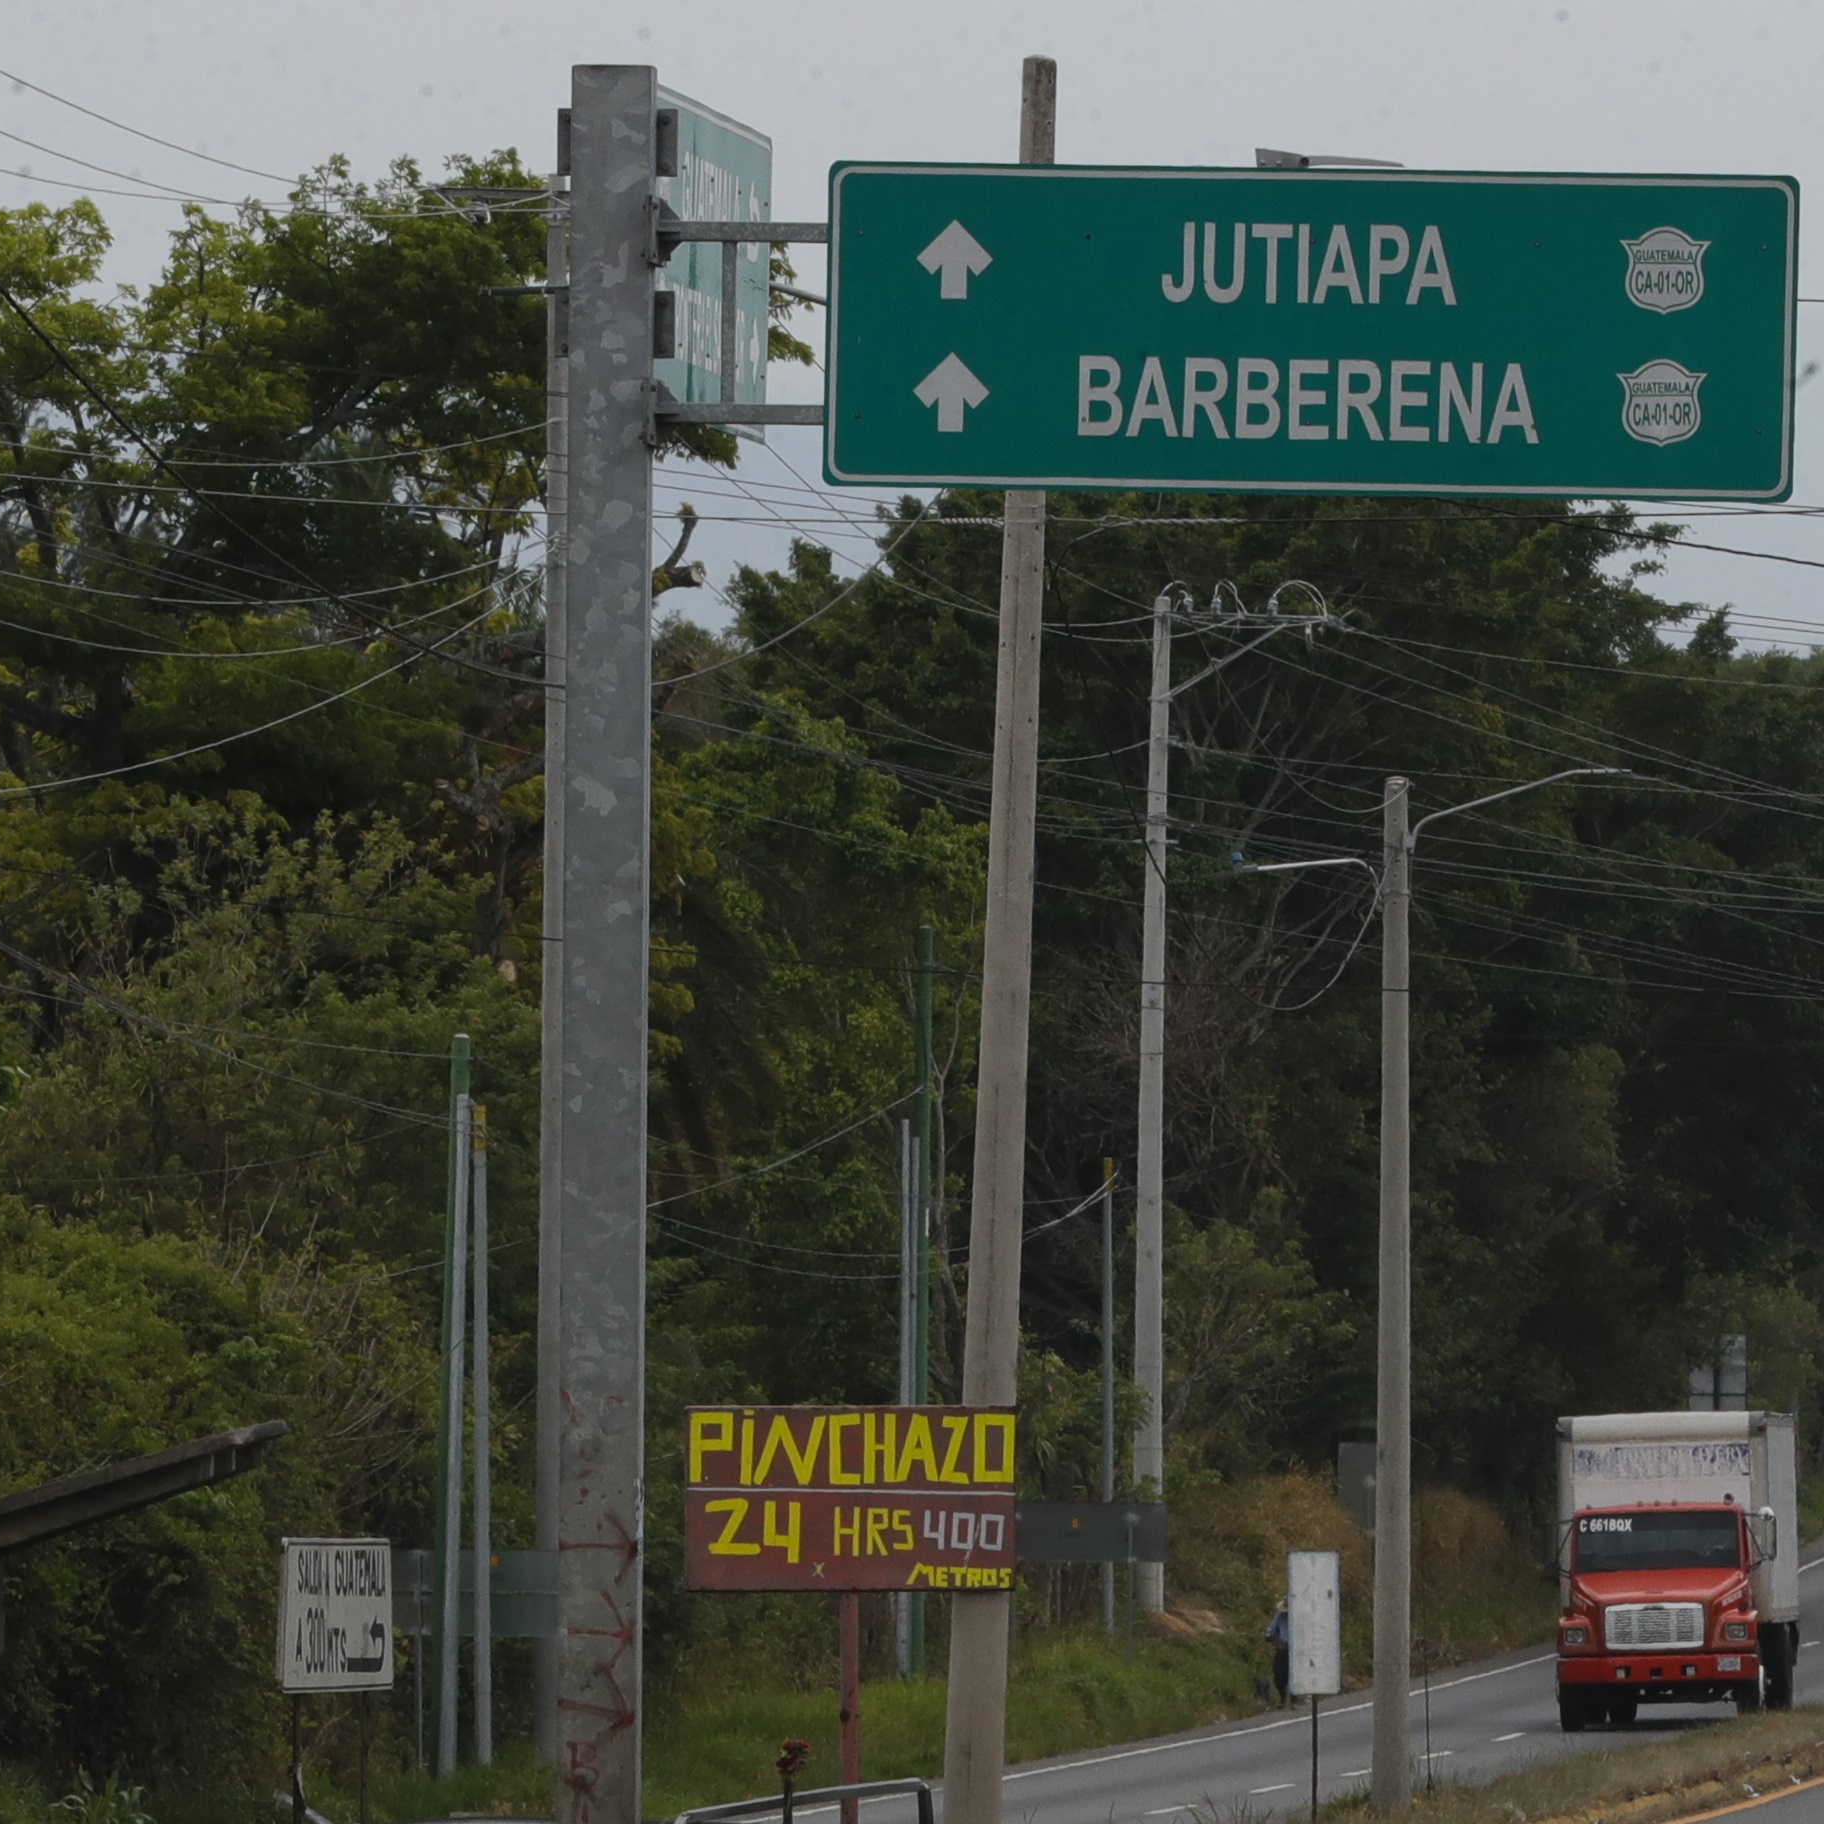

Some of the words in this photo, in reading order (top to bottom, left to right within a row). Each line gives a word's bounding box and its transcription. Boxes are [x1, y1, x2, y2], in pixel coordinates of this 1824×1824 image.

[1161, 221, 1457, 305] JUTIAPA
[1635, 249, 1694, 262] GUATEMALA
[1635, 270, 1694, 294] CA-01-OR
[1077, 354, 1539, 444] BARBERENA
[1632, 381, 1690, 394] GUATEMALA
[1633, 402, 1692, 426] CA-01-OR
[705, 1497, 801, 1564] 24
[833, 1506, 914, 1557] HRS
[923, 1510, 1005, 1551] 400
[1579, 1519, 1588, 1533] C
[1589, 1518, 1634, 1533] 661BQX
[334, 1550, 387, 1597] GUATEMALA
[906, 1561, 1013, 1588] METROS
[295, 1617, 303, 1663] A
